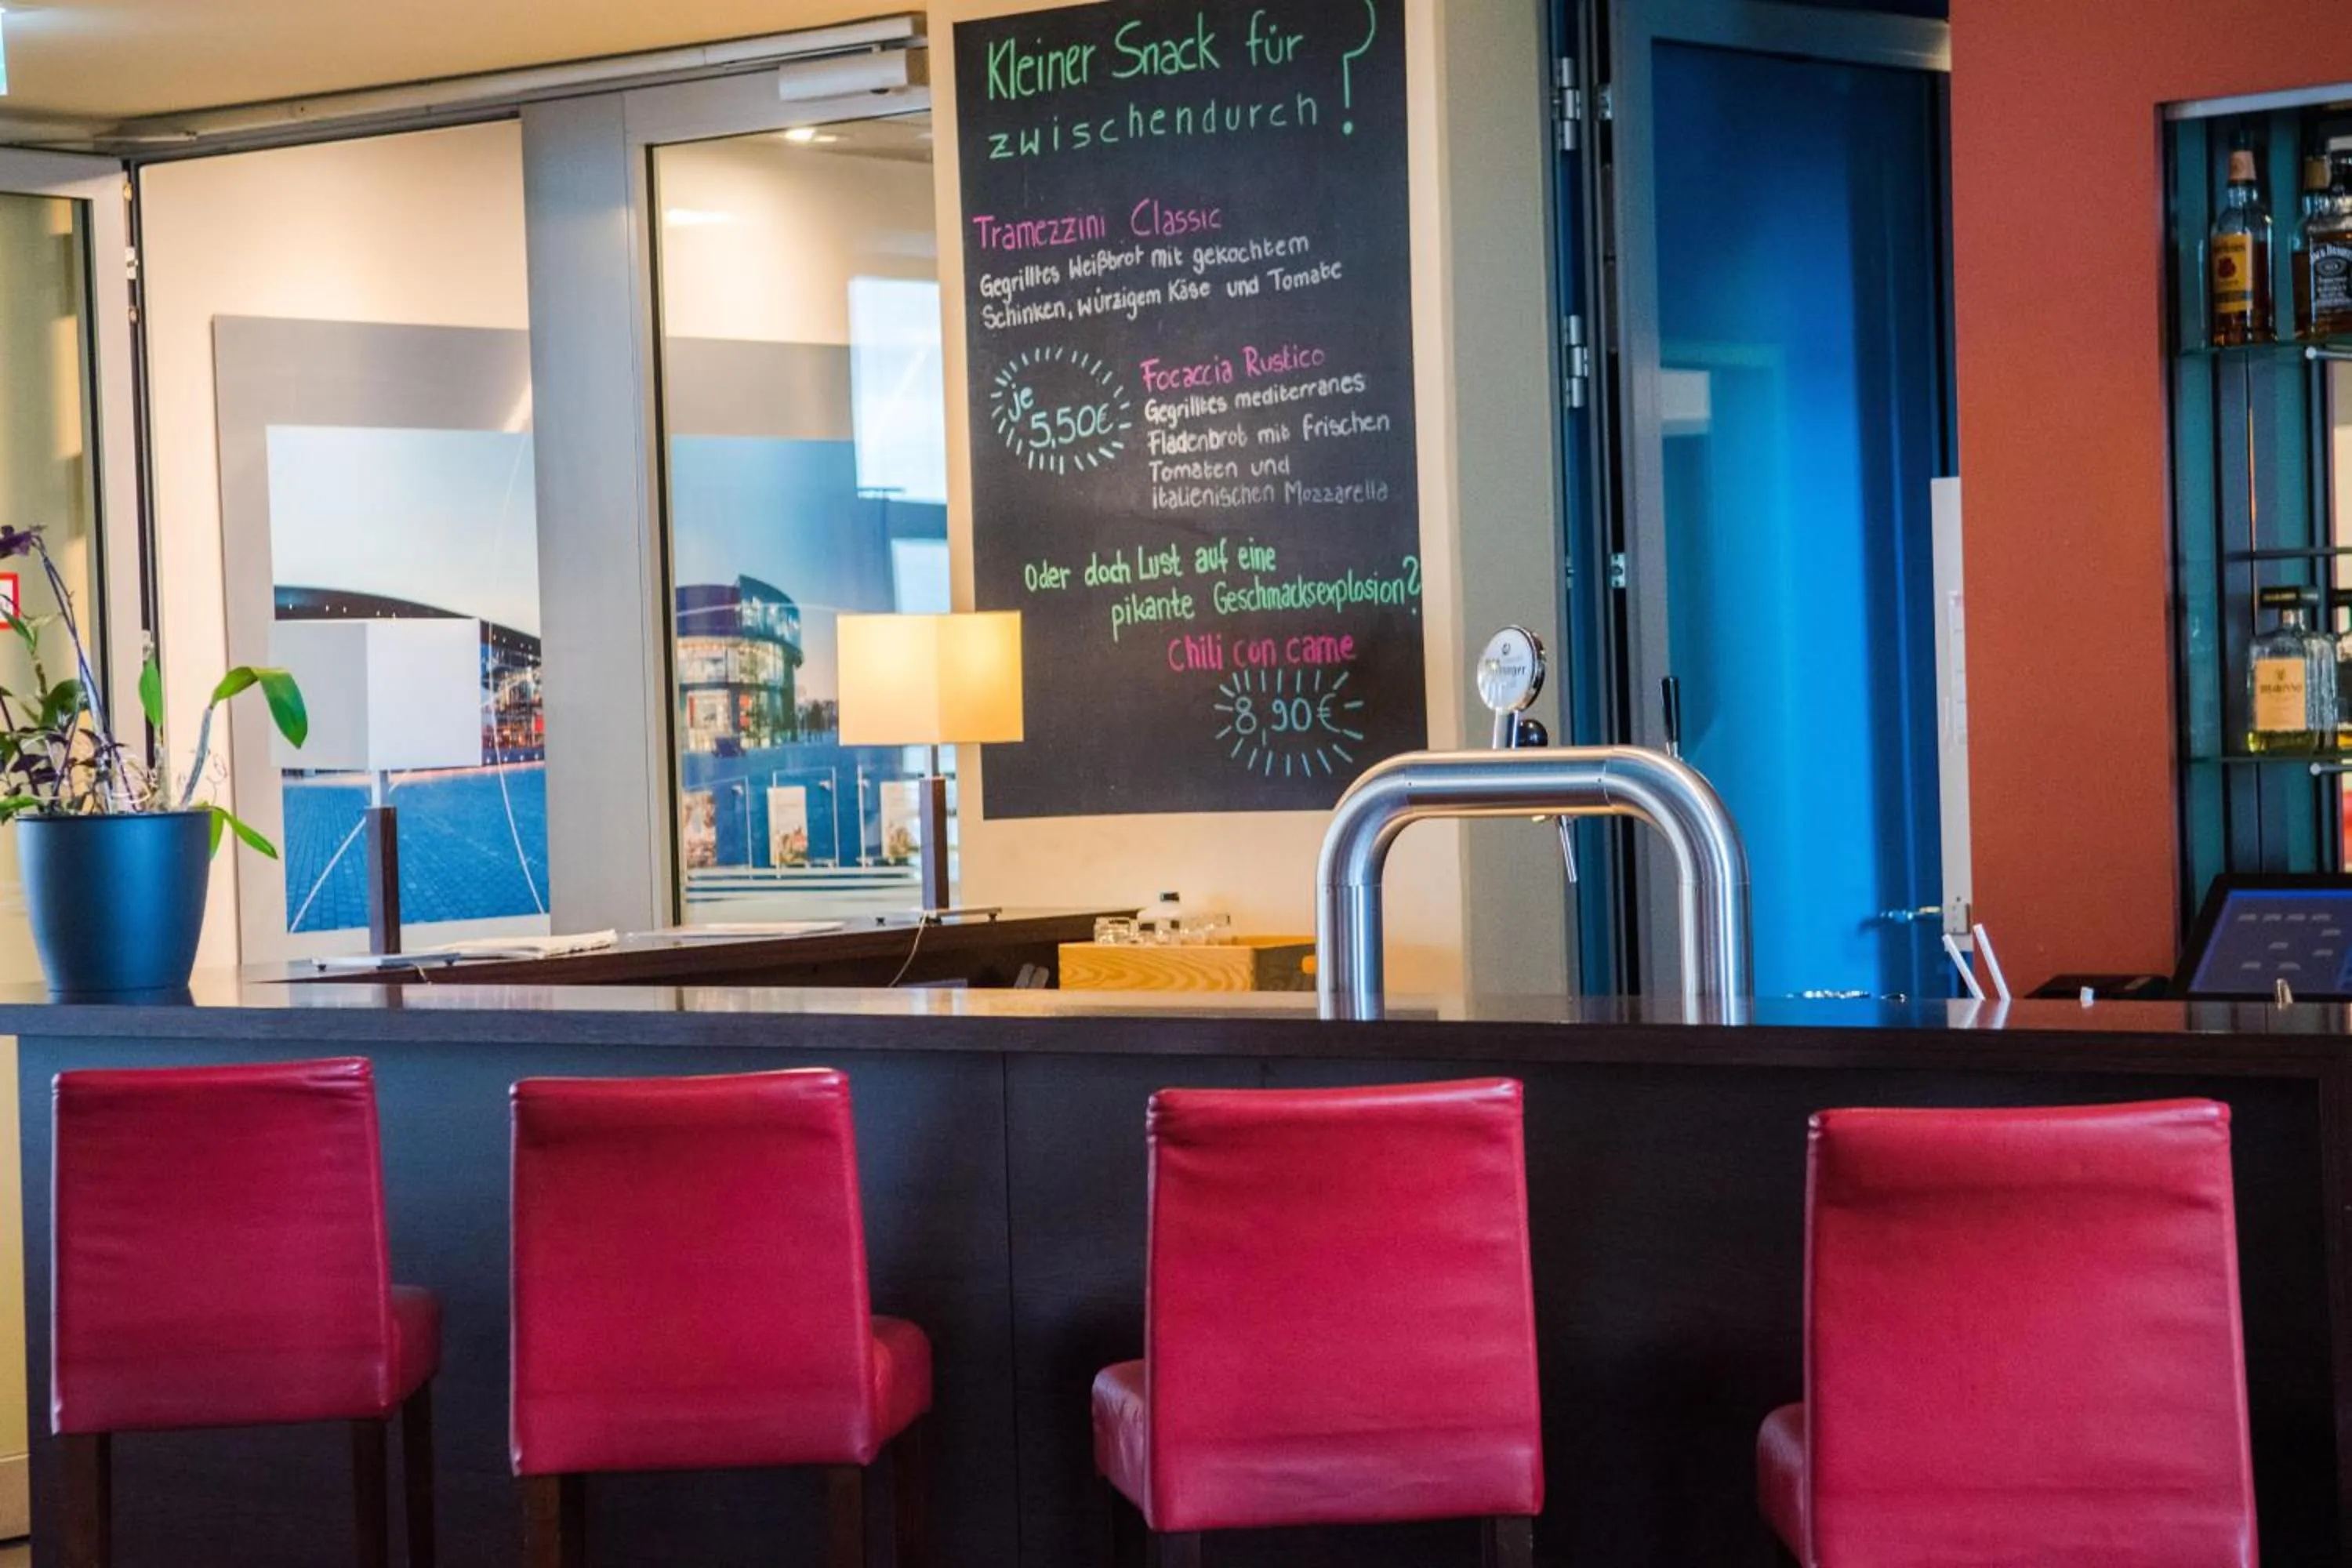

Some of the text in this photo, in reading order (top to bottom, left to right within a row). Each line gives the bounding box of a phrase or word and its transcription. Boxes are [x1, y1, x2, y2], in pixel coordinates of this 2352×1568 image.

[987, 9, 1304, 101] Kleiner Snack für
[988, 93, 1319, 159] zwischendurch
[972, 198, 1222, 250] Tramezzini Classic
[980, 234, 1309, 303] Gegrilltes Weißbrot mit gekochtem
[982, 260, 1343, 331] Schinken, würzigem Käse und Tomate
[1140, 344, 1326, 392] Focaccia Rustico
[1007, 383, 1035, 423] je
[1029, 402, 1115, 449] 5,50€
[1145, 372, 1367, 427] Gegrilltes mediterranes
[1147, 411, 1391, 456] Fladenbrot mit frischen
[1149, 456, 1290, 483] Tomaten und
[1152, 481, 1389, 510] italienischen Mozzarella
[1025, 536, 1276, 592] Oder doch Lust auf eine
[1111, 586, 1196, 643] pikante
[1168, 633, 1356, 670] Chili con carne
